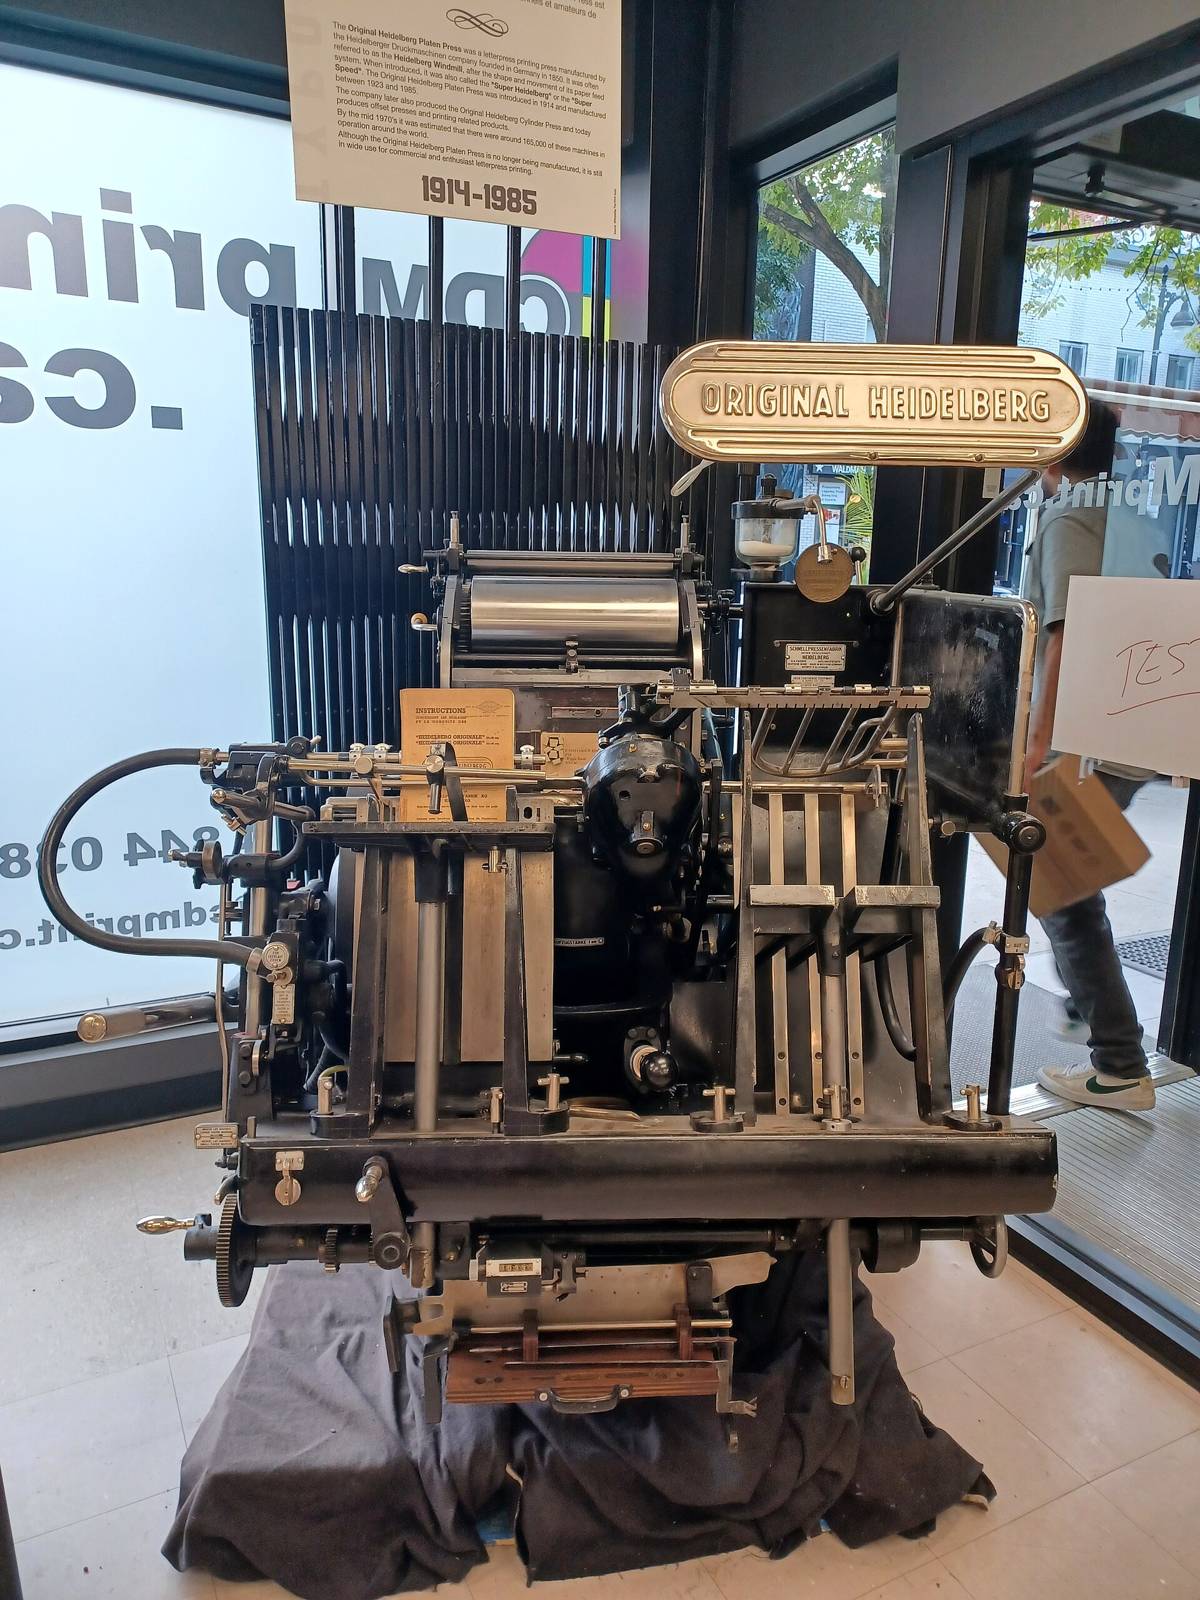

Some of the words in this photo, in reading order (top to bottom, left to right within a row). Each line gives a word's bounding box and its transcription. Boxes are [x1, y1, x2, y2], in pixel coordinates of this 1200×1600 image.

[554, 3, 586, 17] amateurs
[588, 10, 596, 18] de
[333, 22, 346, 30] The
[348, 24, 376, 36] Original
[379, 30, 417, 44] Heidelberg
[419, 38, 440, 48] Platen
[443, 43, 461, 52] Press
[483, 51, 515, 63] letterpress
[517, 59, 539, 69] printing
[541, 64, 557, 72] press
[559, 67, 597, 80] manufactured
[598, 74, 606, 84] by
[334, 32, 344, 41] the
[347, 35, 390, 49] Heidelberger
[392, 43, 446, 59] Druckmaschinen
[448, 54, 477, 66] company
[479, 60, 504, 71] founded
[513, 67, 540, 79] Germany
[585, 81, 599, 90] often
[334, 44, 360, 54] referred
[394, 54, 432, 68] Heidelberg
[494, 72, 512, 84] shape
[514, 77, 525, 85] and
[527, 79, 558, 92] movement
[574, 90, 591, 99] paper
[592, 92, 604, 100] feed
[364, 59, 383, 68] When
[460, 77, 478, 86] called
[480, 79, 489, 87] the
[336, 75, 365, 86] between
[368, 80, 384, 89] 1923
[366, 69, 378, 78] The
[381, 72, 406, 83] Original
[408, 76, 442, 90] Heidelberg
[445, 82, 464, 93] Platen
[466, 87, 484, 96] Press
[499, 94, 532, 106] introduced
[540, 101, 554, 109] 1914
[568, 106, 606, 119] manufactured
[336, 86, 349, 95] The
[351, 89, 382, 102] company
[384, 94, 399, 102] later
[401, 96, 414, 105] also
[416, 99, 446, 111] produced
[448, 104, 458, 112] the
[460, 107, 484, 117] Original
[486, 111, 518, 124] Heidelberg
[520, 117, 544, 128] Cylinder
[545, 122, 561, 131] Press
[575, 128, 591, 137] today
[336, 98, 369, 108] produces
[371, 102, 389, 112] offset
[391, 106, 416, 116] presses
[432, 113, 456, 123] printing
[458, 117, 479, 126] related
[338, 119, 370, 130] operation
[372, 124, 395, 134] around
[397, 127, 407, 135] the
[409, 129, 429, 139] world.
[338, 130, 369, 141] Although
[370, 134, 381, 142] the
[383, 136, 408, 147] Original
[410, 141, 444, 154] Heidelberg
[446, 146, 466, 155] Platen
[468, 149, 484, 158] Press
[502, 155, 521, 165] longer
[522, 158, 539, 168] being
[540, 160, 581, 174] manufactured,
[349, 110, 359, 118] the
[376, 115, 398, 124] 1970's
[420, 122, 451, 133] estimated
[467, 129, 482, 137] there
[500, 135, 521, 144] around
[523, 138, 546, 149] 165,000
[555, 144, 571, 152] these
[572, 146, 599, 158] machines
[347, 141, 363, 150] wide
[389, 148, 427, 159] commercial
[428, 152, 440, 161] and
[442, 154, 474, 166] enthusiast
[476, 161, 508, 172] letterpress
[509, 165, 533, 176] printing.
[422, 175, 537, 215] 1914-1985
[702, 382, 849, 418] ORIGINAL
[869, 385, 1050, 422] HEIDELBERG
[1116, 634, 1200, 698] TES
